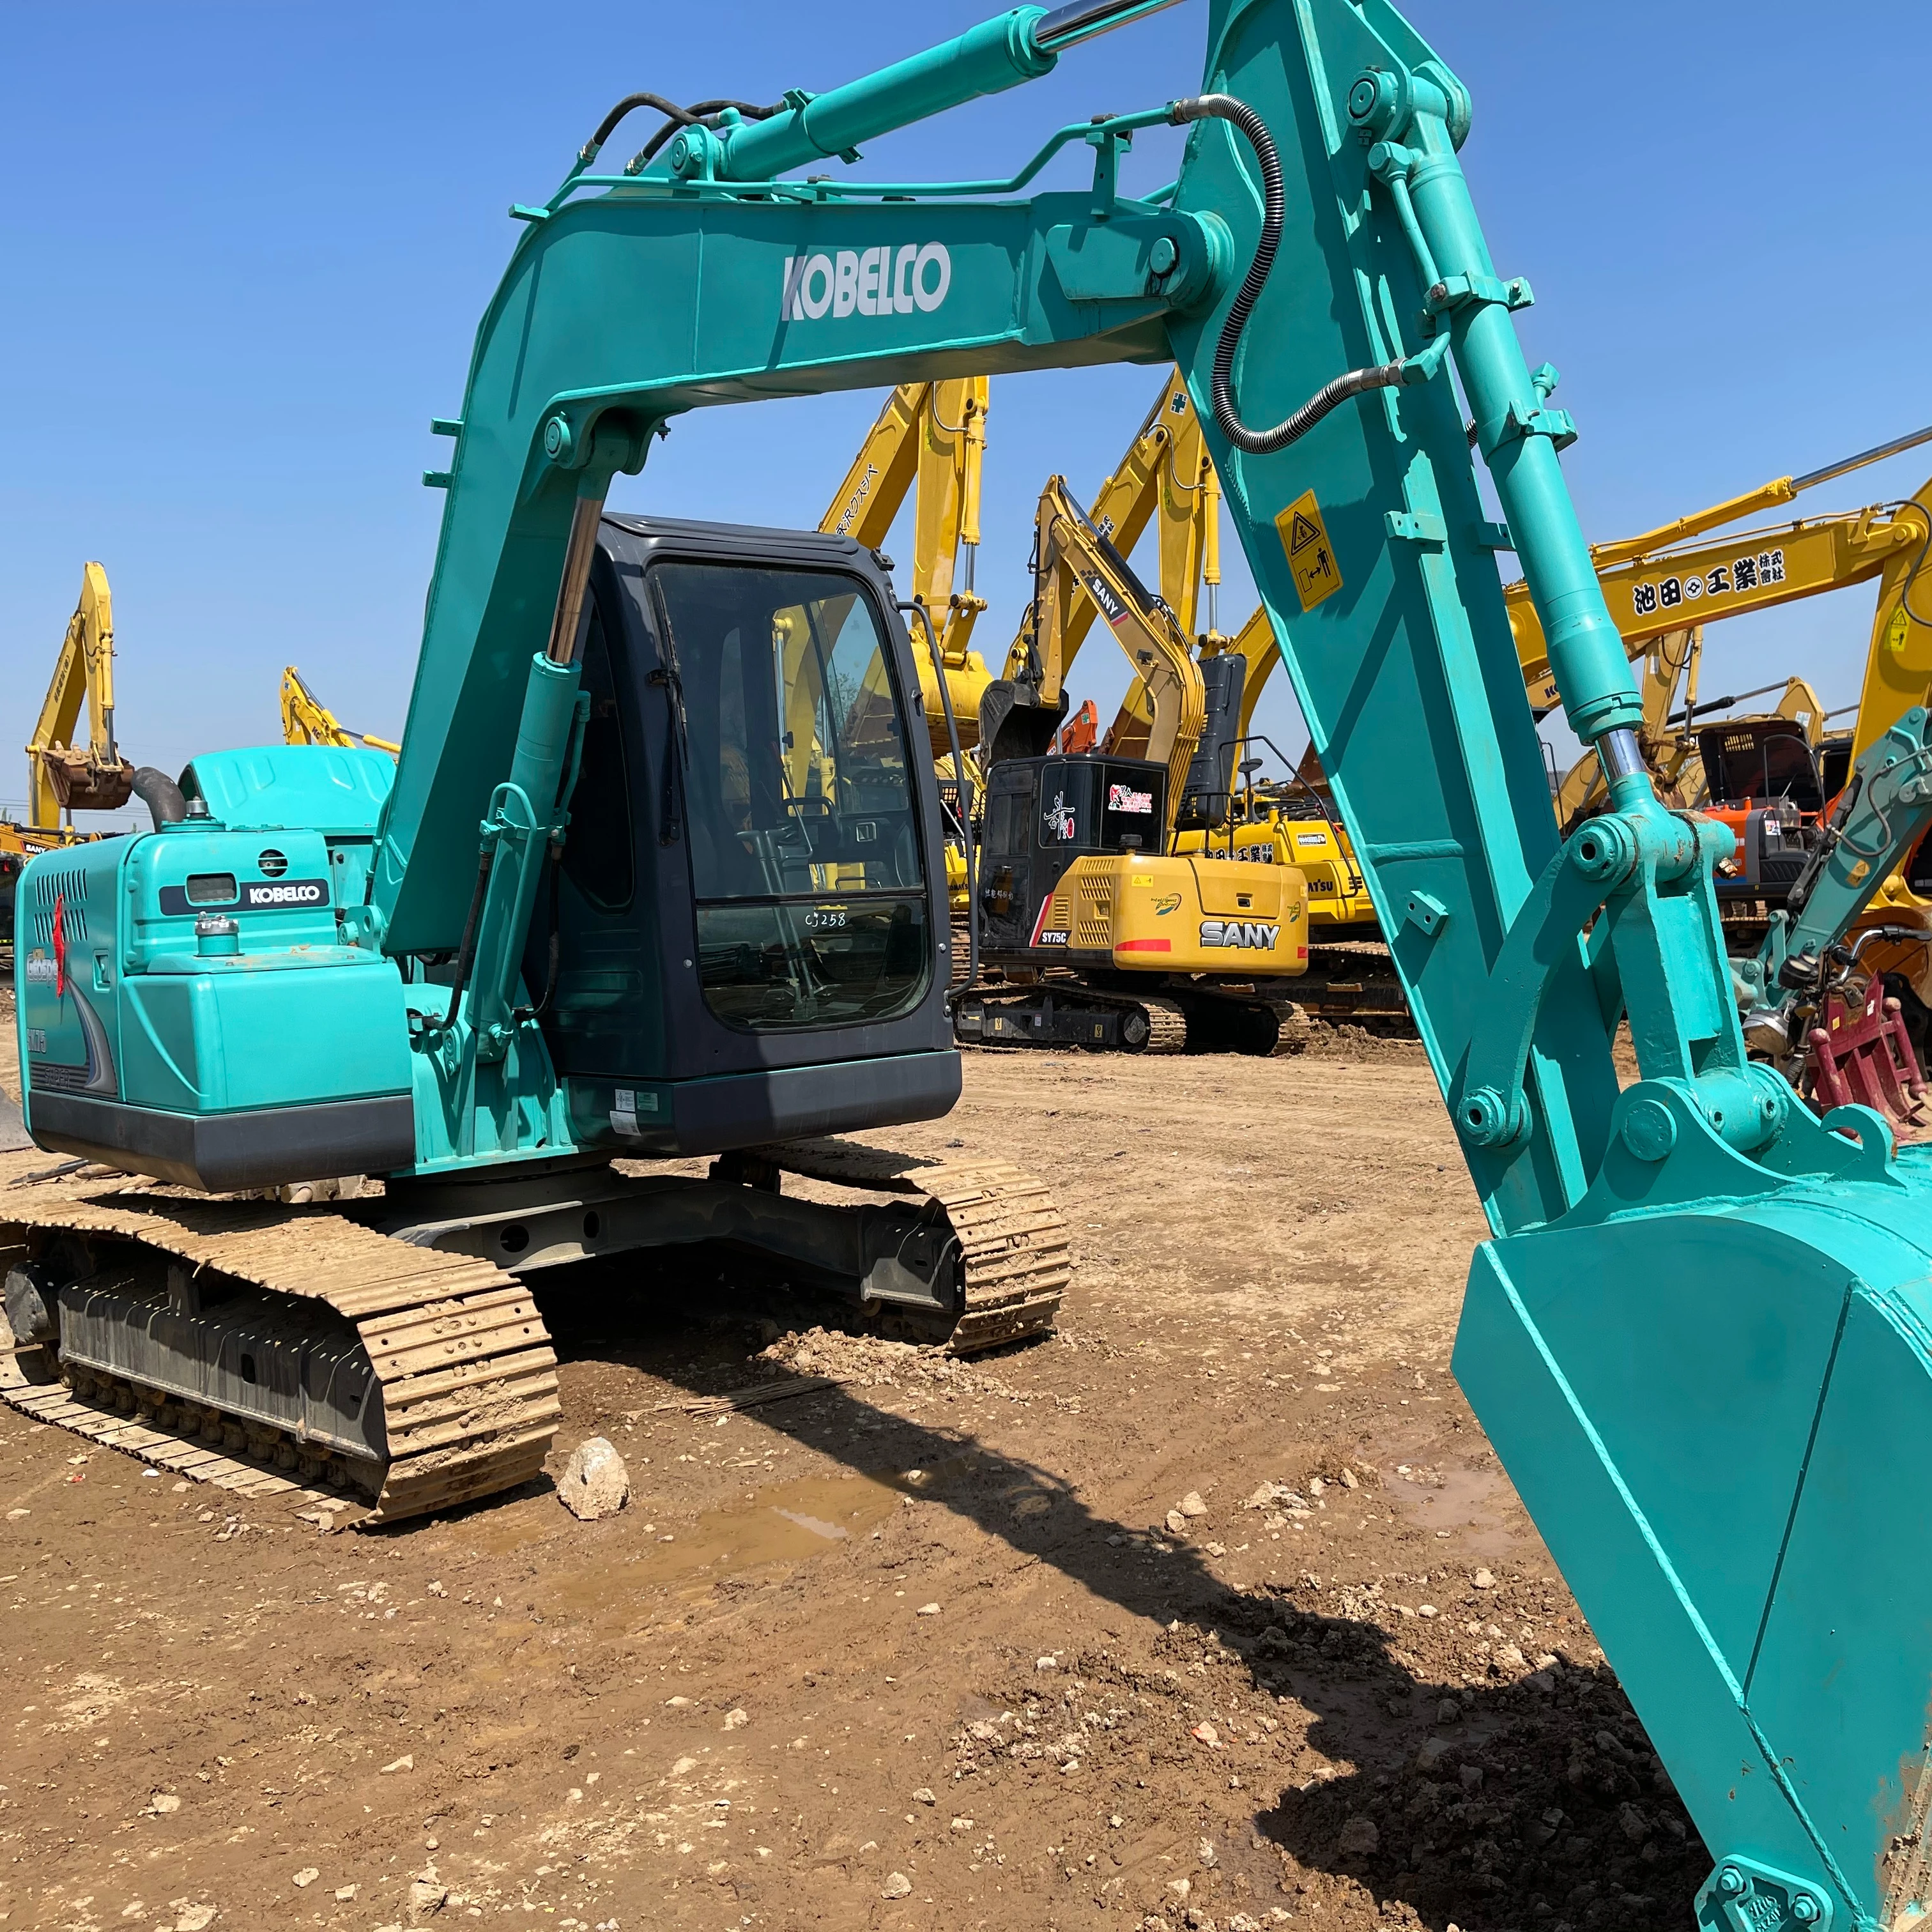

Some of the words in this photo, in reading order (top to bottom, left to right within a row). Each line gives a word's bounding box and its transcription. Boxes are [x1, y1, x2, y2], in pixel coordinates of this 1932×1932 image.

[781, 241, 951, 321] KOBELCO
[1092, 578, 1119, 615] SANY
[249, 885, 320, 904] KOBELCO
[1041, 931, 1067, 943] SY75C
[1199, 921, 1281, 950] SANY
